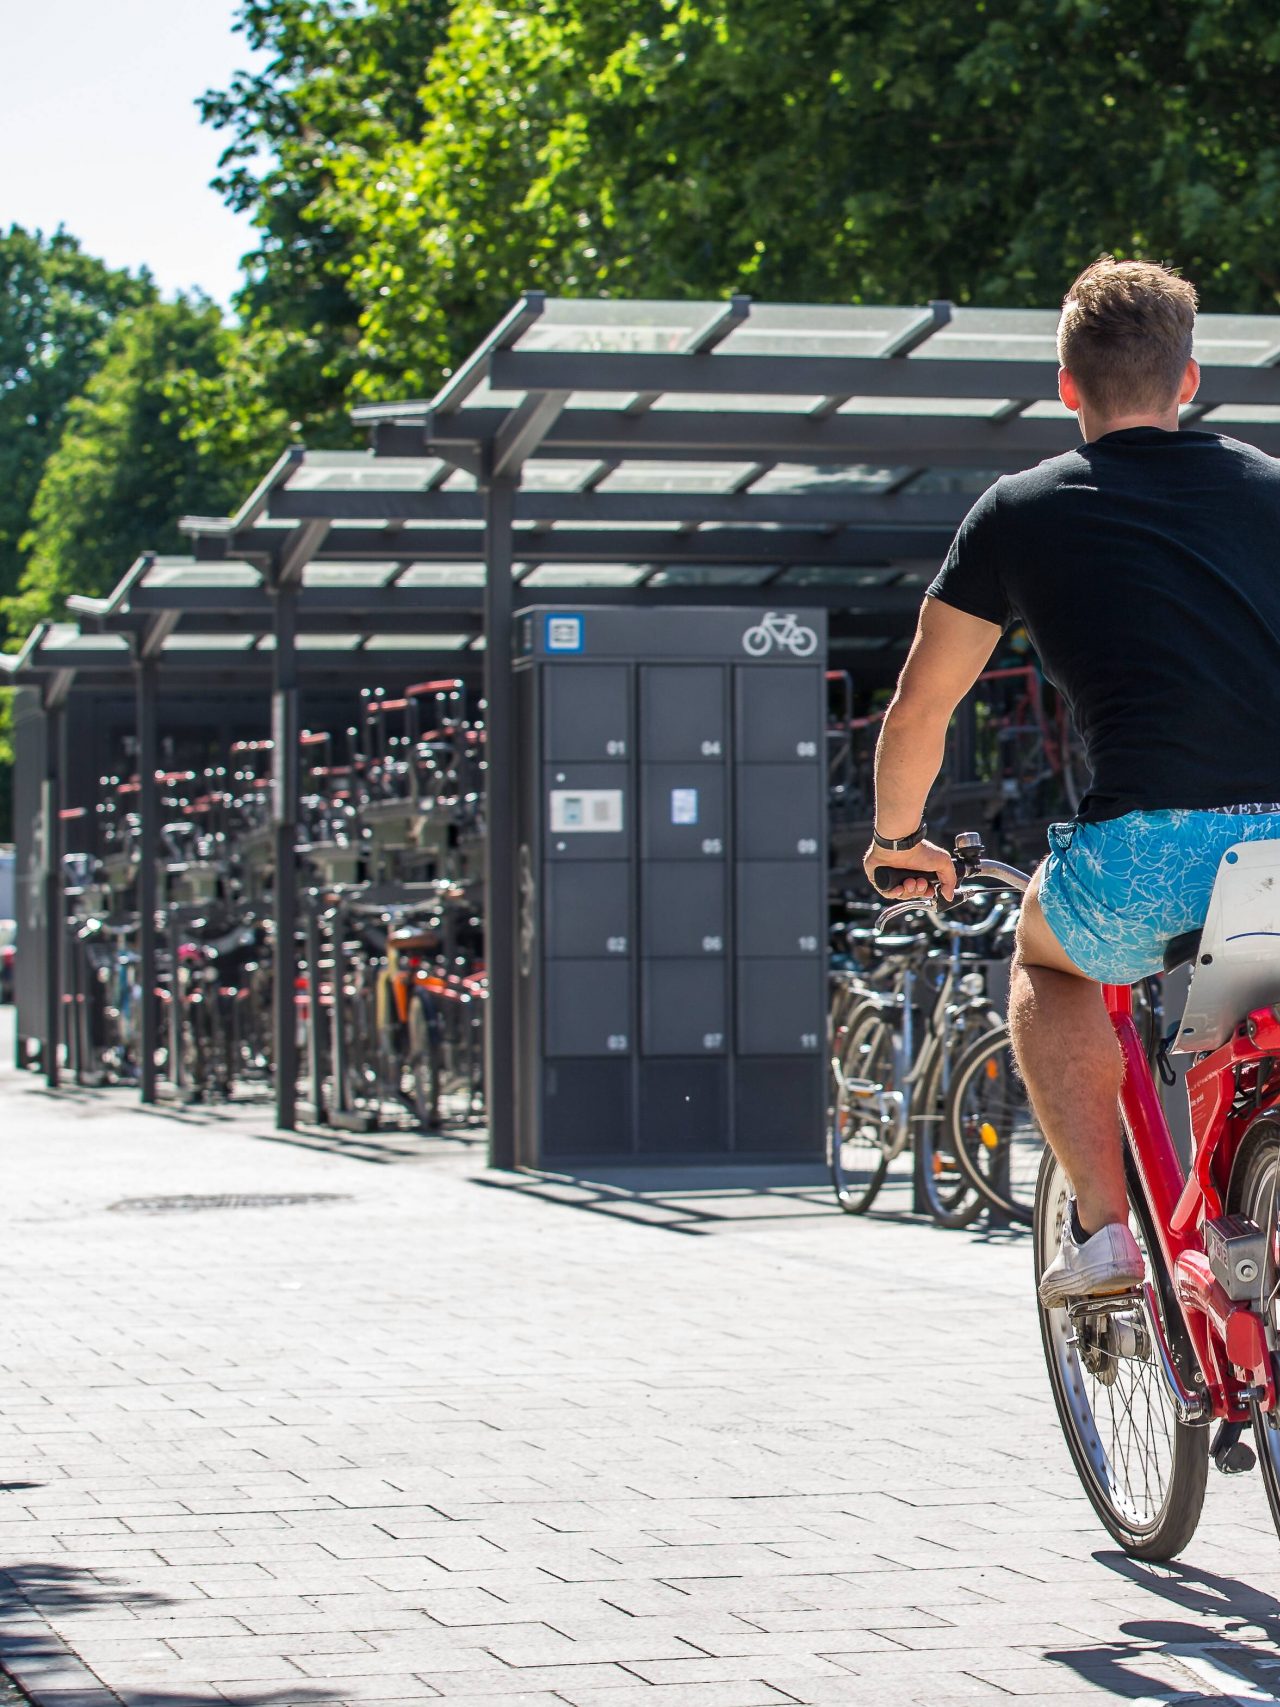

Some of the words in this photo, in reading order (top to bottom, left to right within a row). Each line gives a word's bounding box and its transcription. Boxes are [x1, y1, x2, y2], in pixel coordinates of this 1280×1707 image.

[607, 740, 626, 756] 01
[701, 740, 721, 756] 04
[799, 935, 818, 951] 10
[703, 1032, 723, 1048] 07
[800, 1033, 818, 1048] 11
